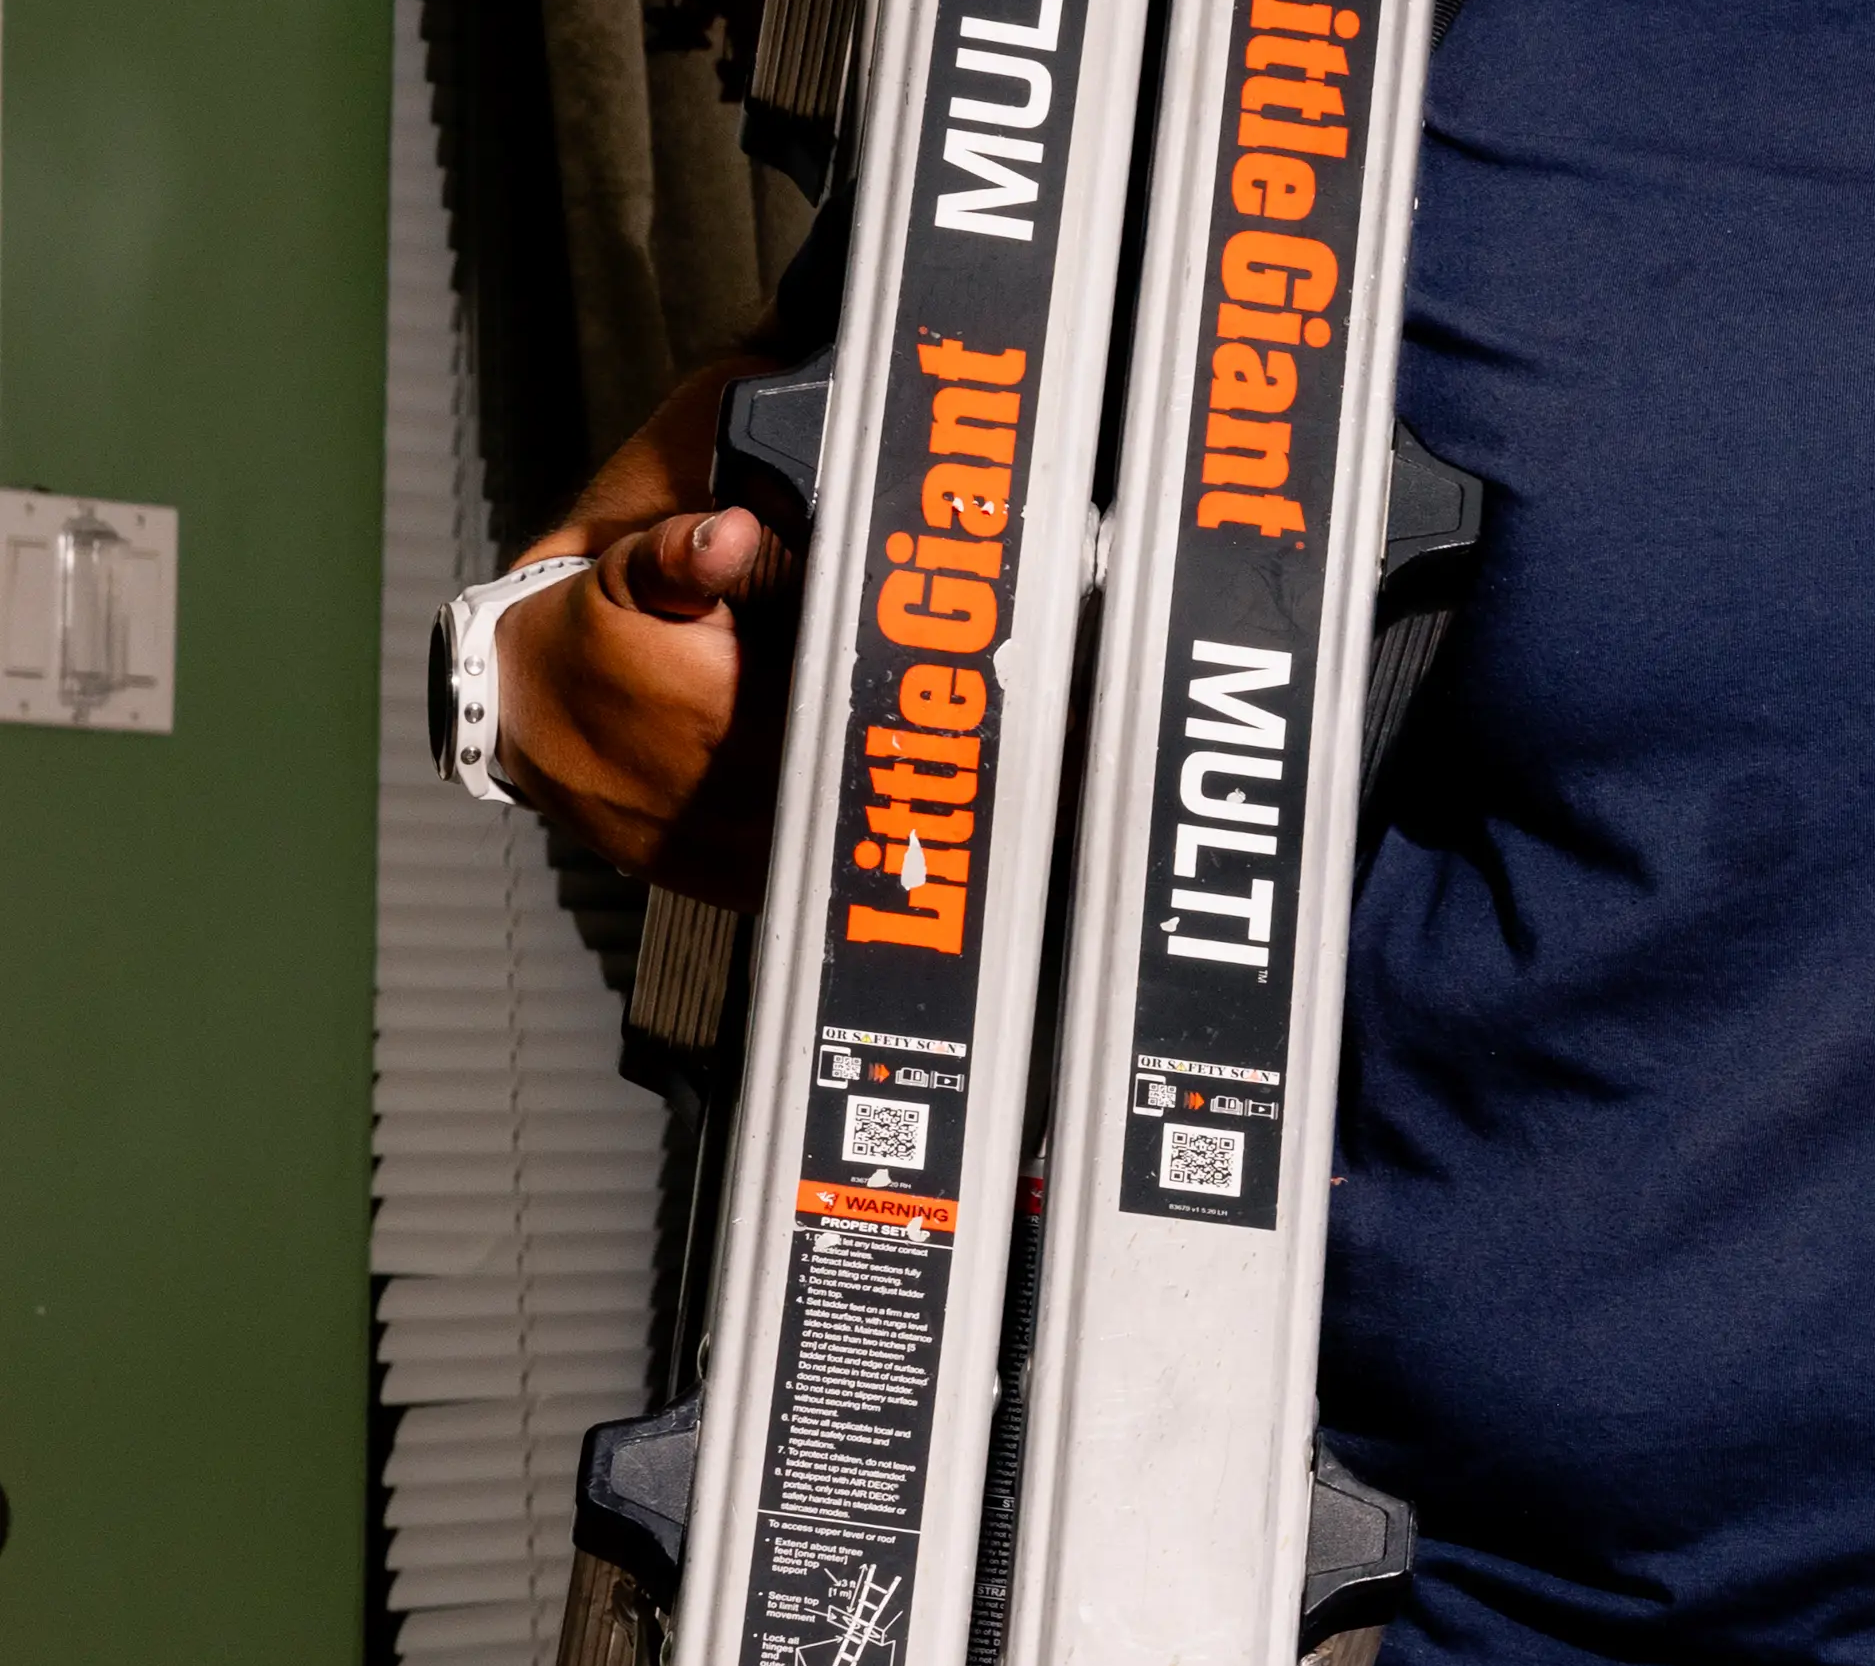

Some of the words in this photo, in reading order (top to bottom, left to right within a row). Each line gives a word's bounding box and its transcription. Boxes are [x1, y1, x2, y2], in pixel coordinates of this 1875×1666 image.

[825, 1027, 847, 1040] QR
[1140, 1055, 1162, 1068] QR
[844, 1195, 950, 1222] WARNING
[819, 1216, 879, 1234] PROPER
[853, 1240, 870, 1250] any
[870, 1242, 897, 1252] ladder
[897, 1245, 929, 1257] contact
[809, 1264, 837, 1276] before
[836, 1268, 860, 1281] lifting
[810, 1254, 842, 1266] Retract
[841, 1258, 869, 1270] ladder
[869, 1263, 904, 1275] sections
[903, 1266, 922, 1279] fully
[806, 1285, 827, 1297] from
[822, 1277, 837, 1287] not
[837, 1280, 861, 1291] move
[871, 1284, 898, 1296] adjust
[897, 1287, 925, 1299] ladder
[805, 1296, 822, 1307] Set
[821, 1298, 849, 1310] ladder
[848, 1302, 866, 1313] feet
[885, 1307, 903, 1317] firm
[902, 1310, 920, 1320] and
[791, 1414, 819, 1426] Follow
[819, 1417, 830, 1427] all
[830, 1419, 873, 1434] applicable
[873, 1425, 894, 1436] local
[893, 1428, 911, 1439] and
[798, 1448, 829, 1461] protect
[877, 1459, 892, 1469] not
[892, 1461, 916, 1472] leave
[790, 1469, 831, 1483] equipped
[831, 1475, 849, 1485] with
[848, 1476, 866, 1487] AIR
[780, 1521, 813, 1533] access
[813, 1526, 842, 1538] upper
[842, 1528, 865, 1540] level
[876, 1533, 896, 1544] roof
[773, 1545, 793, 1558] feet
[774, 1536, 808, 1550] Extend
[809, 1542, 837, 1553] about
[837, 1545, 863, 1557] three
[771, 1563, 807, 1576] support
[772, 1554, 802, 1566] above
[803, 1558, 820, 1569] top
[767, 1591, 802, 1603] Secure
[803, 1596, 819, 1606] top
[778, 1601, 799, 1612] limit
[765, 1609, 815, 1623] movement
[762, 1632, 786, 1643] Lock
[786, 1635, 800, 1645] all
[760, 1650, 779, 1661] and
[761, 1641, 794, 1654] hinges
